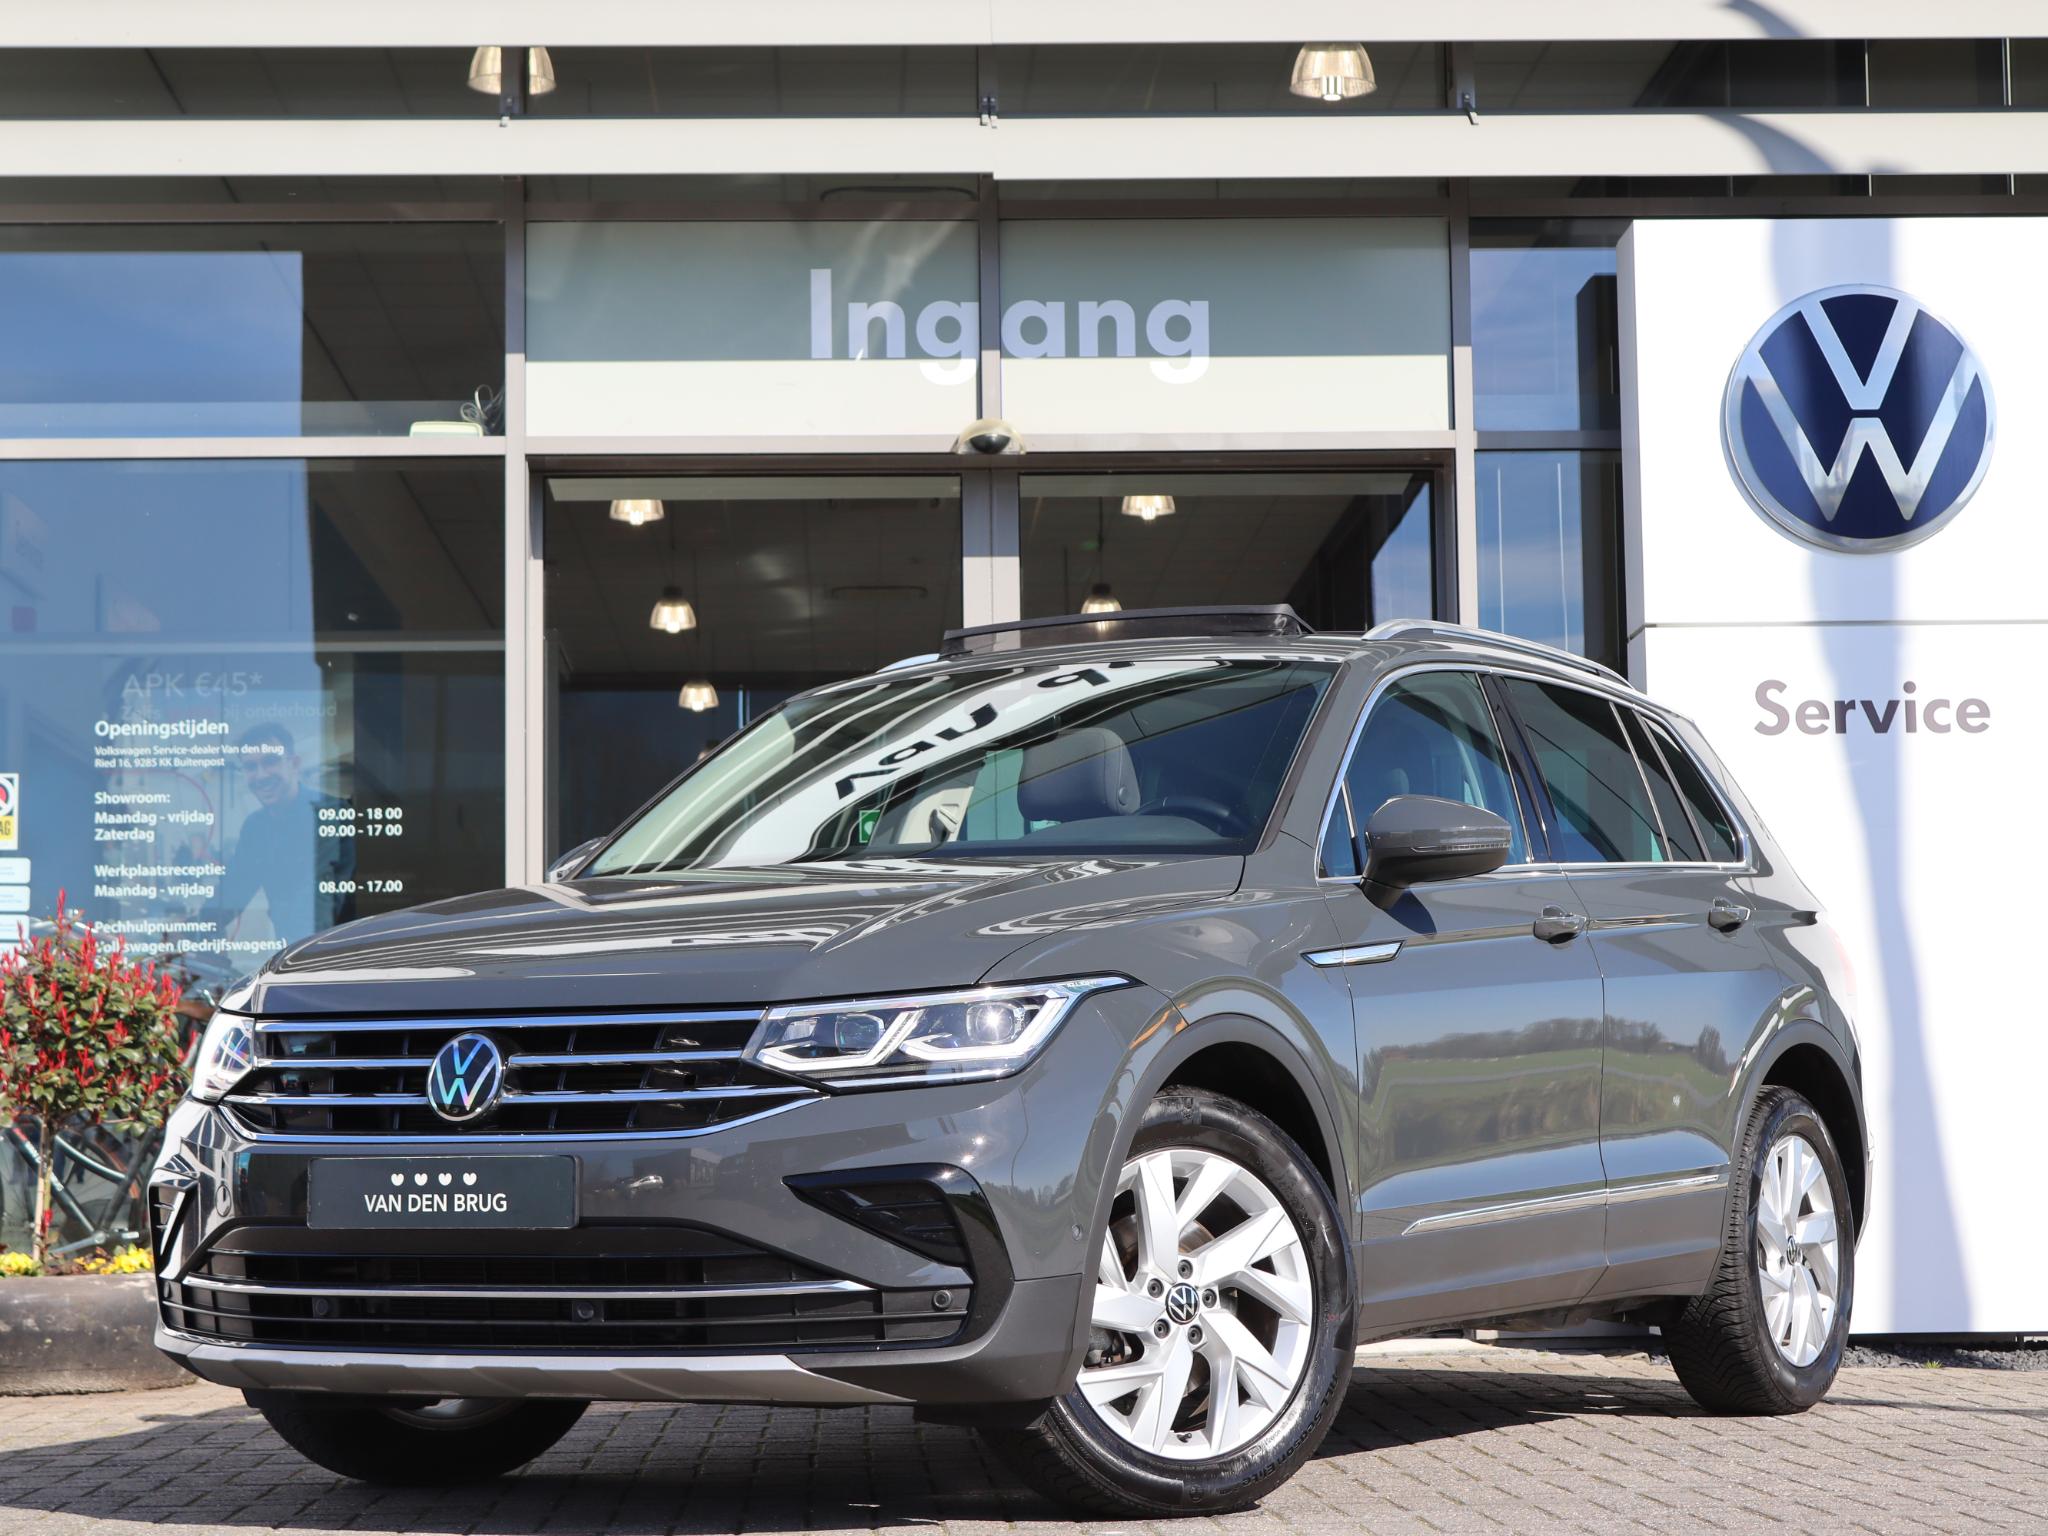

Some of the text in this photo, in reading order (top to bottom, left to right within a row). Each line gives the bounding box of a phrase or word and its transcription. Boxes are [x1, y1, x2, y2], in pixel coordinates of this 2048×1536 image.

[810, 268, 1210, 386] Ingang
[121, 673, 185, 697] APK
[1754, 679, 1991, 736] Service
[94, 719, 230, 740] Openingstijden
[94, 743, 284, 757] Volkswagen Service-dealer Van den Brug
[94, 757, 225, 769] Ried 16, 9285 KK Buitenpost
[94, 791, 171, 804] Showroom:
[94, 811, 157, 826] Maandag
[167, 810, 215, 825] vrijdag
[318, 808, 356, 821] 09.00
[94, 828, 155, 843] Zaterdag
[318, 824, 356, 837] 09.00
[94, 863, 226, 878] Werkplaatsreceptie:
[94, 884, 157, 899] Maandag
[167, 882, 215, 898] vrijdag
[318, 880, 356, 893] 08.00
[366, 880, 404, 893] 17.00
[94, 919, 217, 936] Pechhulpnummer:
[177, 937, 288, 955] (Bedrijfswagens)
[364, 1192, 508, 1213] VAN DEN BRUG
